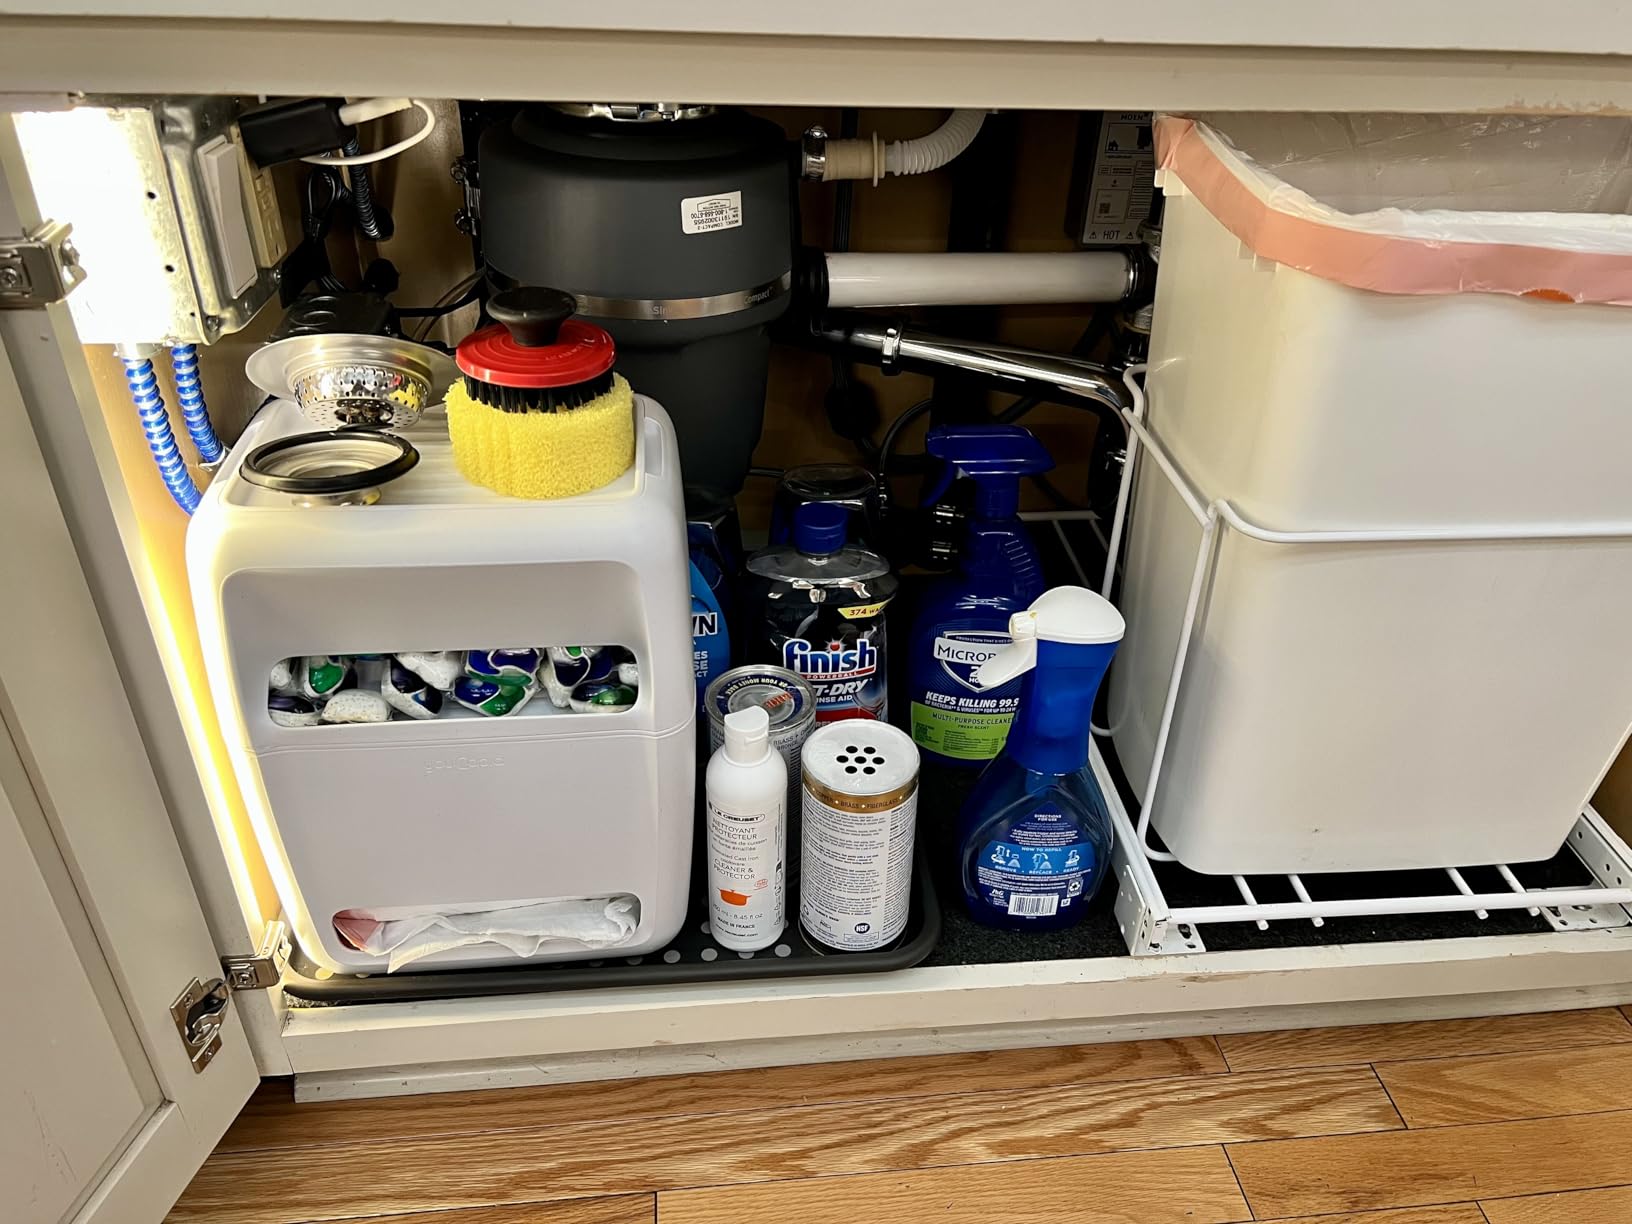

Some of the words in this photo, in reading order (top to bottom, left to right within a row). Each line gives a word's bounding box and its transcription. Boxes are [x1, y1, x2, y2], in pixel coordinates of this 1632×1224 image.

[1103, 230, 1121, 240] HOT
[849, 608, 867, 616] 374
[783, 639, 876, 674] finish
[806, 671, 858, 679] POWERBALL
[738, 677, 760, 687] MONEY
[760, 677, 777, 685] YOUR
[814, 679, 869, 697] T-DRY
[838, 694, 853, 702] AID
[925, 691, 957, 705] KEEPS
[958, 698, 997, 708] KILLING
[932, 712, 985, 725] MULTI-PURPOSE
[722, 813, 760, 822] CREUSET
[712, 817, 757, 834] NETTOYANT
[711, 823, 758, 840] PROTECTEUR
[714, 858, 747, 873] CLEANER
[994, 865, 1017, 873] REMOVE
[713, 863, 756, 880] PROTECTOR
[856, 924, 870, 932] NSF
